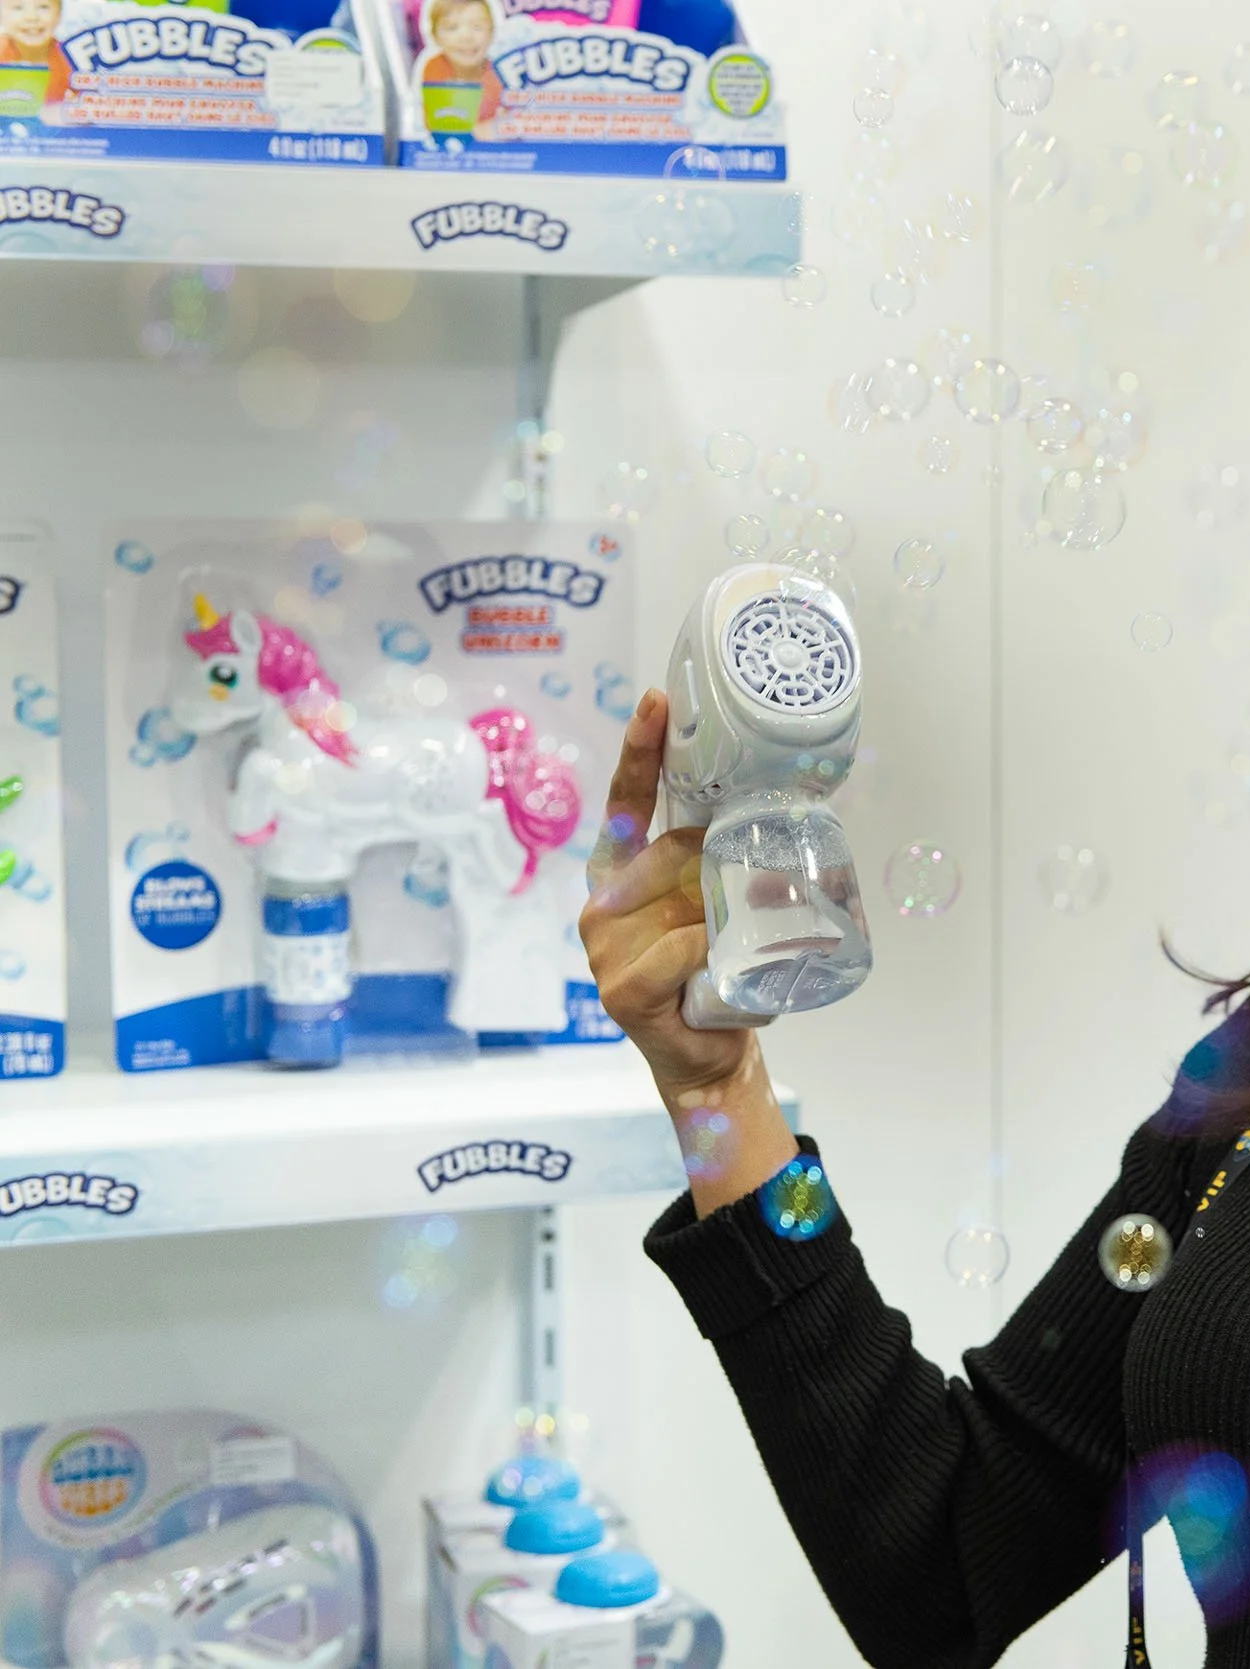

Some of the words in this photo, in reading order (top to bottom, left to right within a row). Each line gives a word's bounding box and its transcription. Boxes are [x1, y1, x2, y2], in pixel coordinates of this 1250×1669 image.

[63, 17, 272, 77] FUBBLES
[493, 35, 690, 92] FUBBLES
[0, 186, 126, 238] BBLES
[411, 201, 568, 251] FUBBLES
[420, 554, 605, 614] FUBBLES
[417, 1140, 572, 1193] FUBBLES
